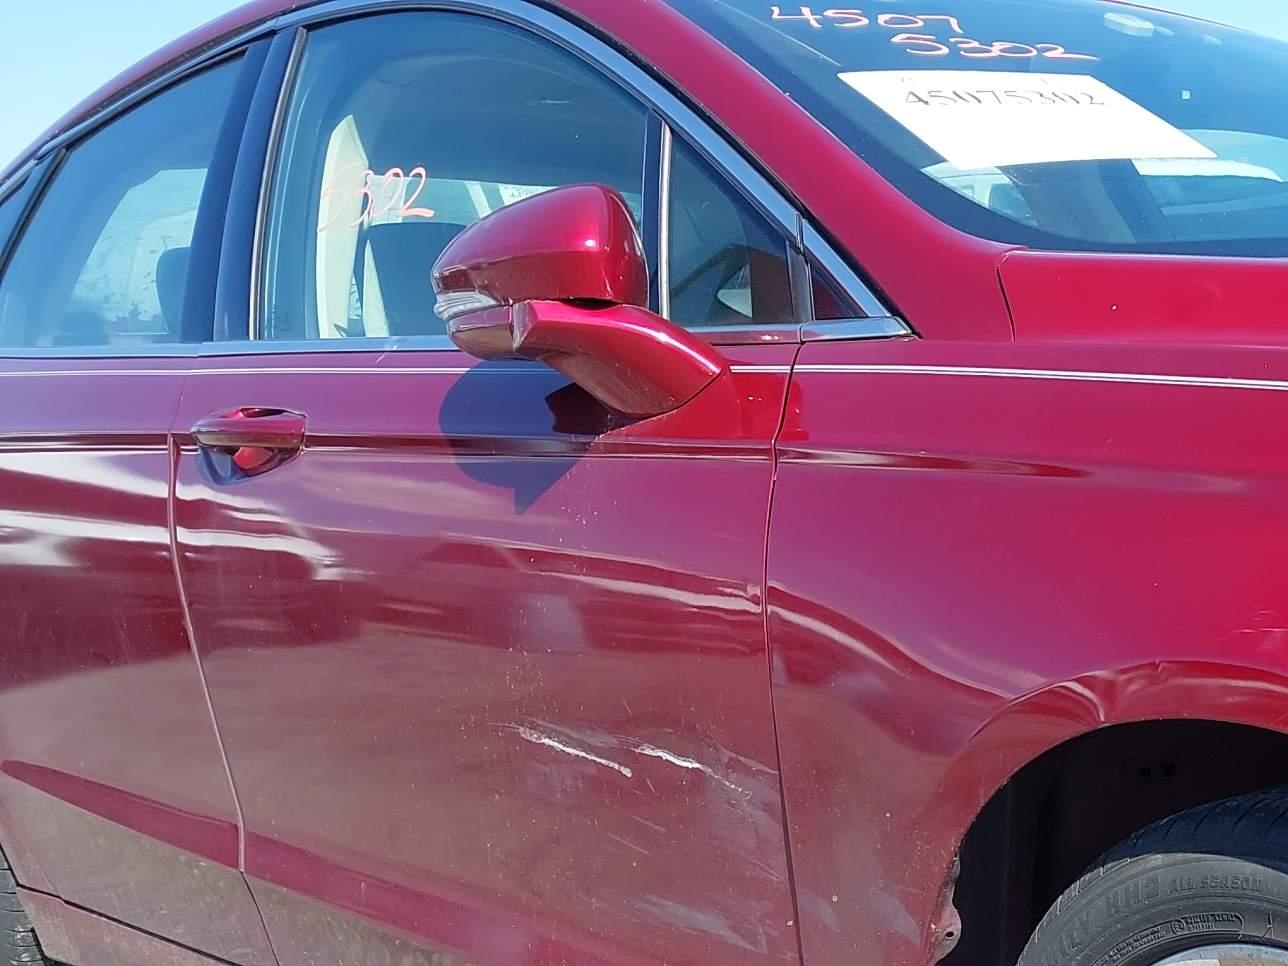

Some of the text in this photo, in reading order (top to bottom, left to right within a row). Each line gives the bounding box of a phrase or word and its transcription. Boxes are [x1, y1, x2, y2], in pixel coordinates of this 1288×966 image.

[770, 6, 964, 34] 4507
[890, 33, 1100, 60] 5302
[905, 90, 1105, 106] 45075302
